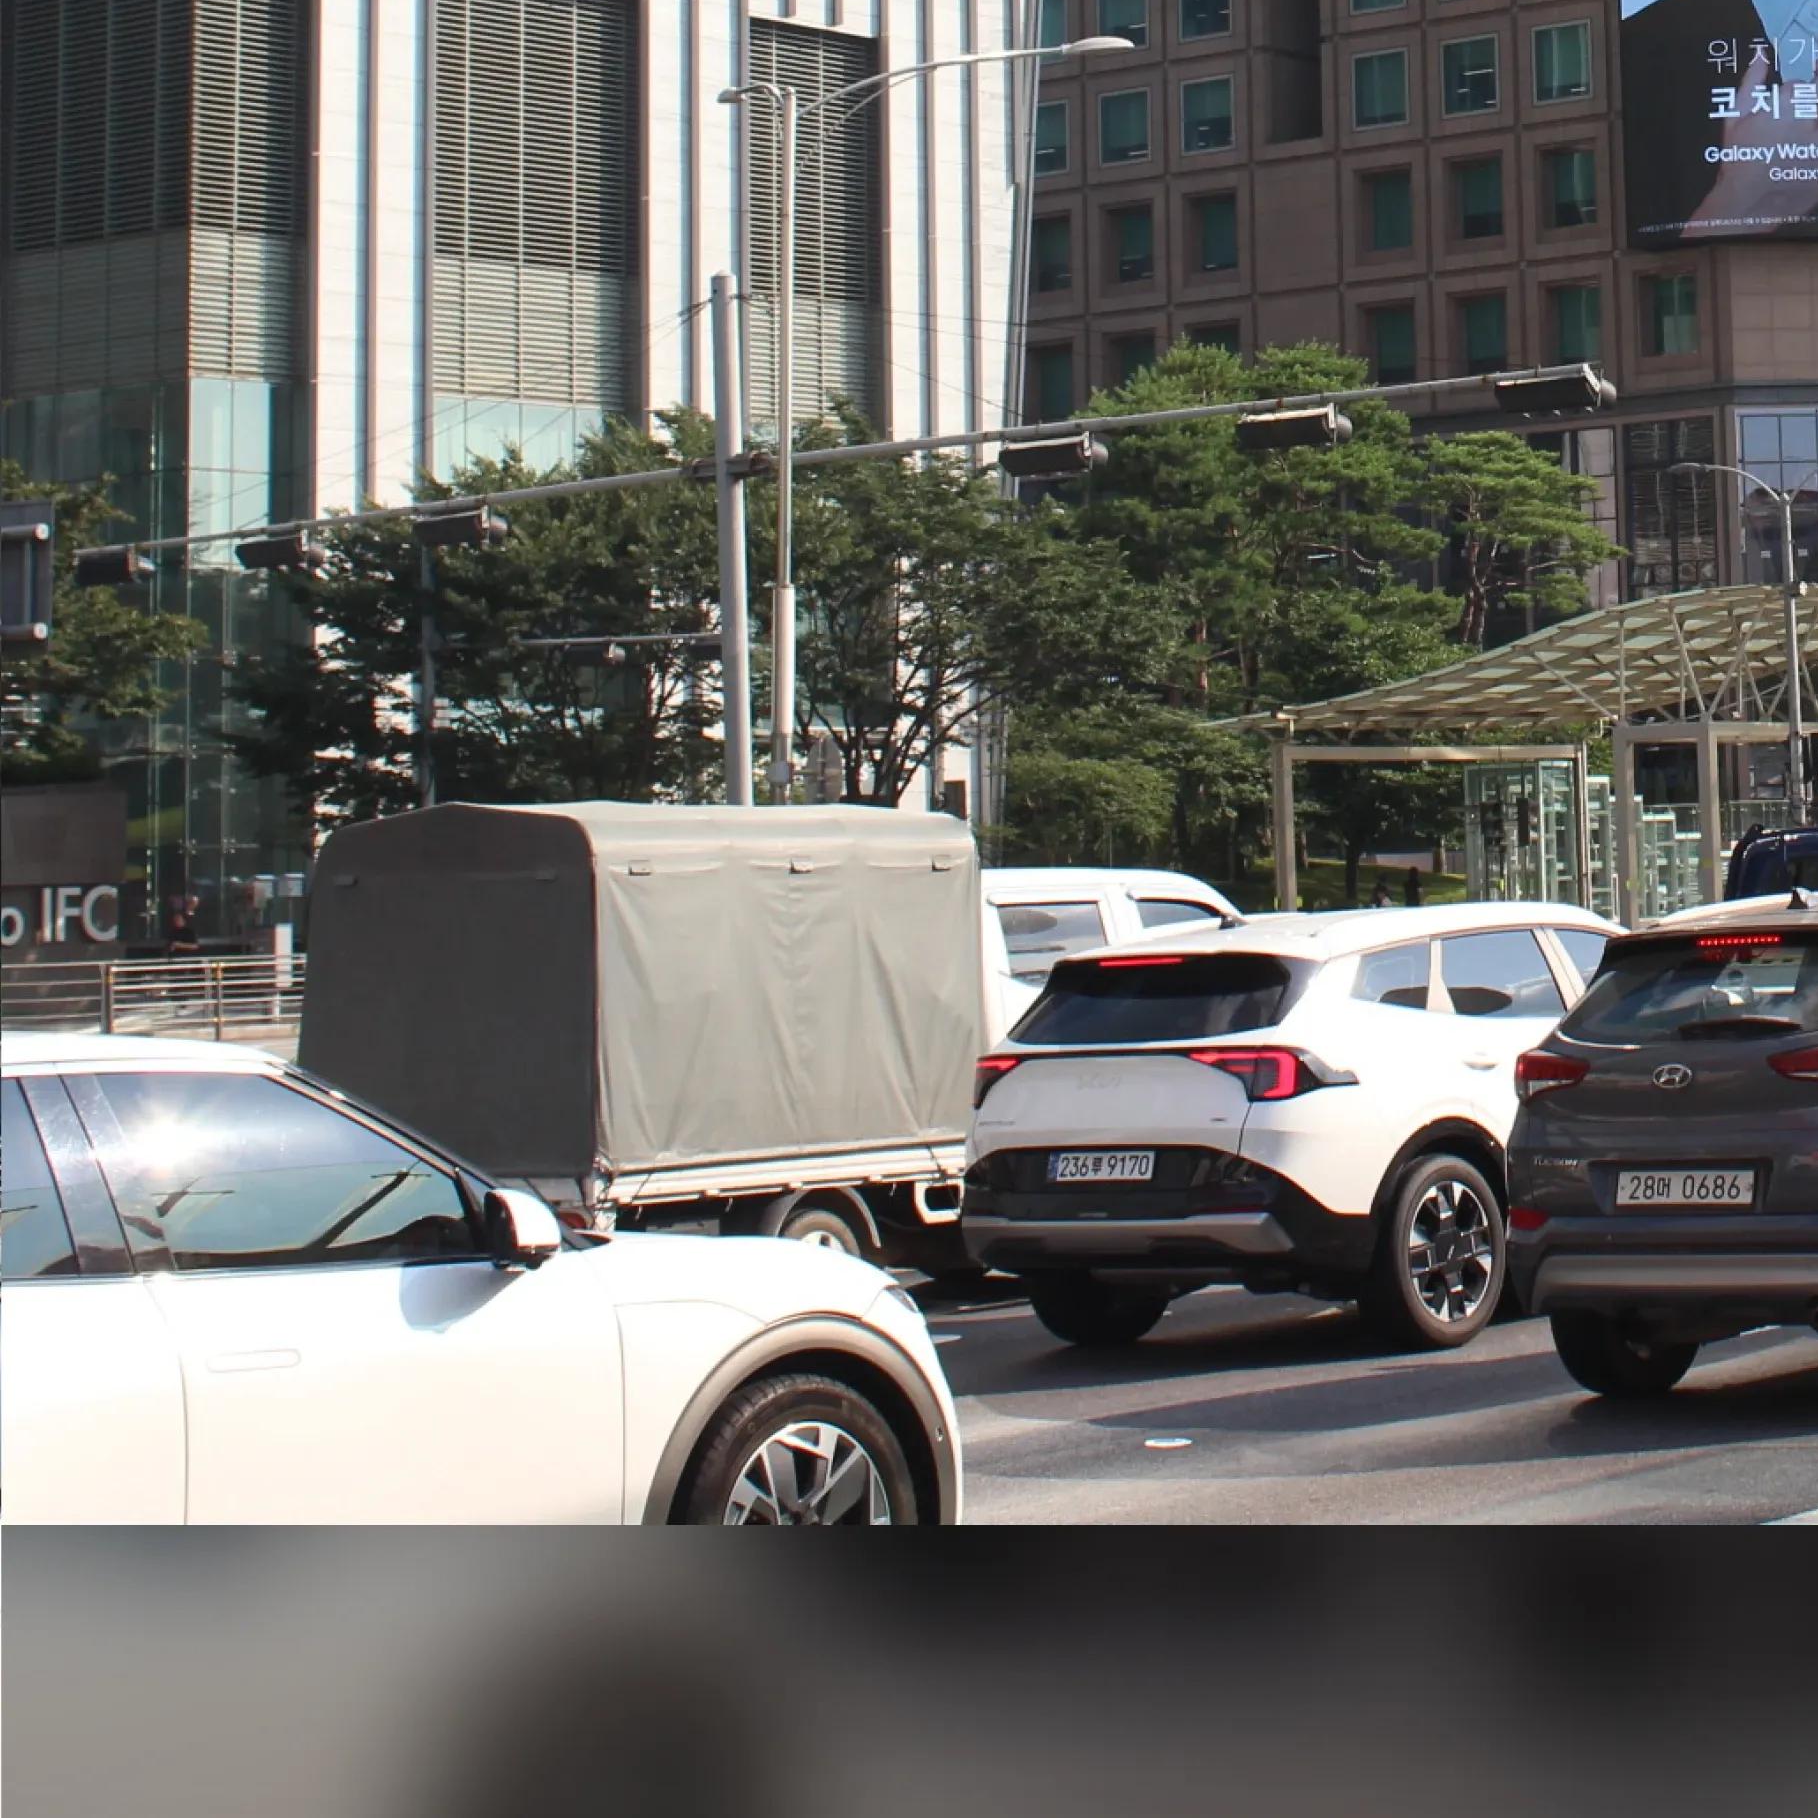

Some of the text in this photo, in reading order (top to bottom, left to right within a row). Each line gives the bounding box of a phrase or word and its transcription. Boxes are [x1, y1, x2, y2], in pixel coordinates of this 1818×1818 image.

[1704, 144, 1774, 164] Galaxy
[42, 885, 118, 942] IFC
[1107, 1155, 1150, 1177] 9170
[1681, 1174, 1741, 1200] 0686
